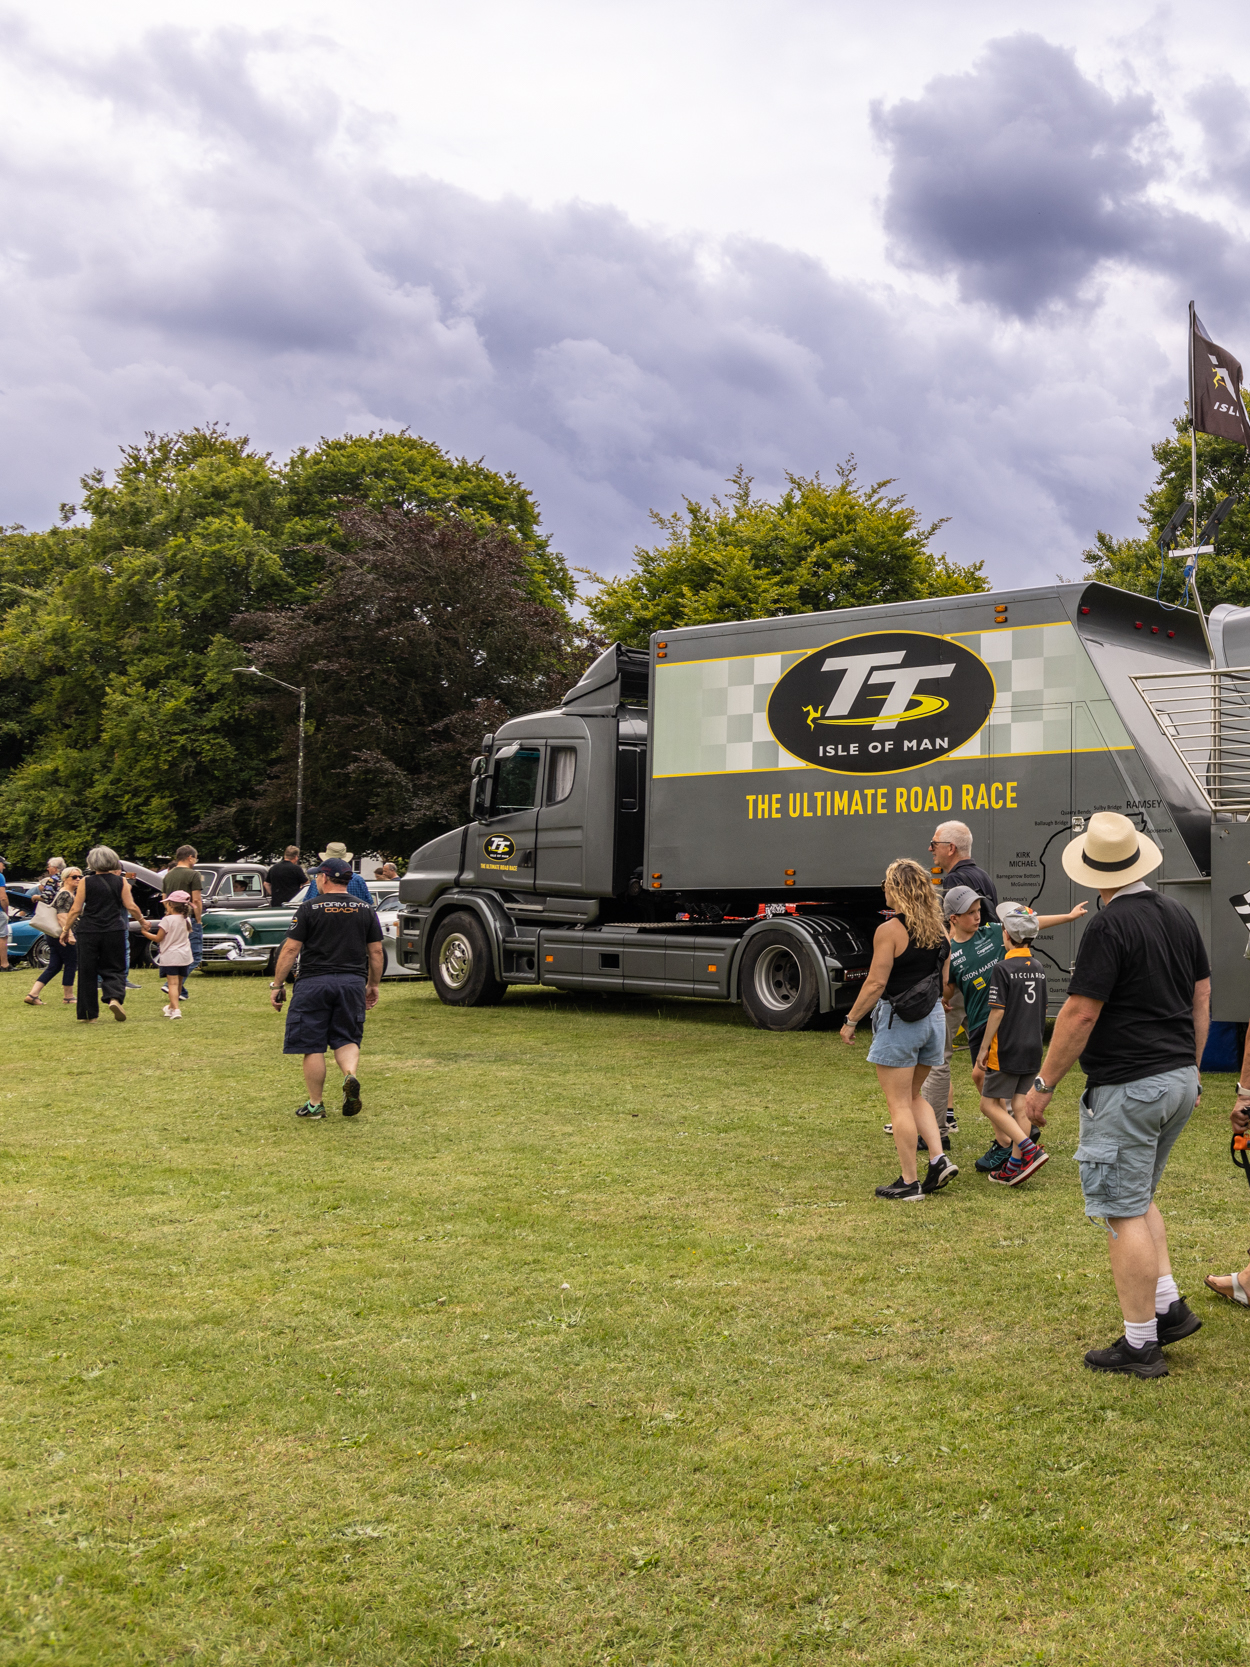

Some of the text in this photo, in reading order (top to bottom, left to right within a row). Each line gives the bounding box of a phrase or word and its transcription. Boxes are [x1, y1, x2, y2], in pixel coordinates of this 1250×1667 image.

[820, 650, 956, 731] TT
[818, 737, 950, 757] ISLE OF MAN
[746, 782, 1018, 819] THE ULTIMATE ROAD RACE
[1126, 799, 1162, 810] RAMSEY
[491, 837, 511, 854] TT
[1016, 851, 1031, 859] KIRK
[1009, 860, 1037, 868] MICHAEL
[311, 902, 347, 910] STORM
[1024, 981, 1036, 1004] 3
